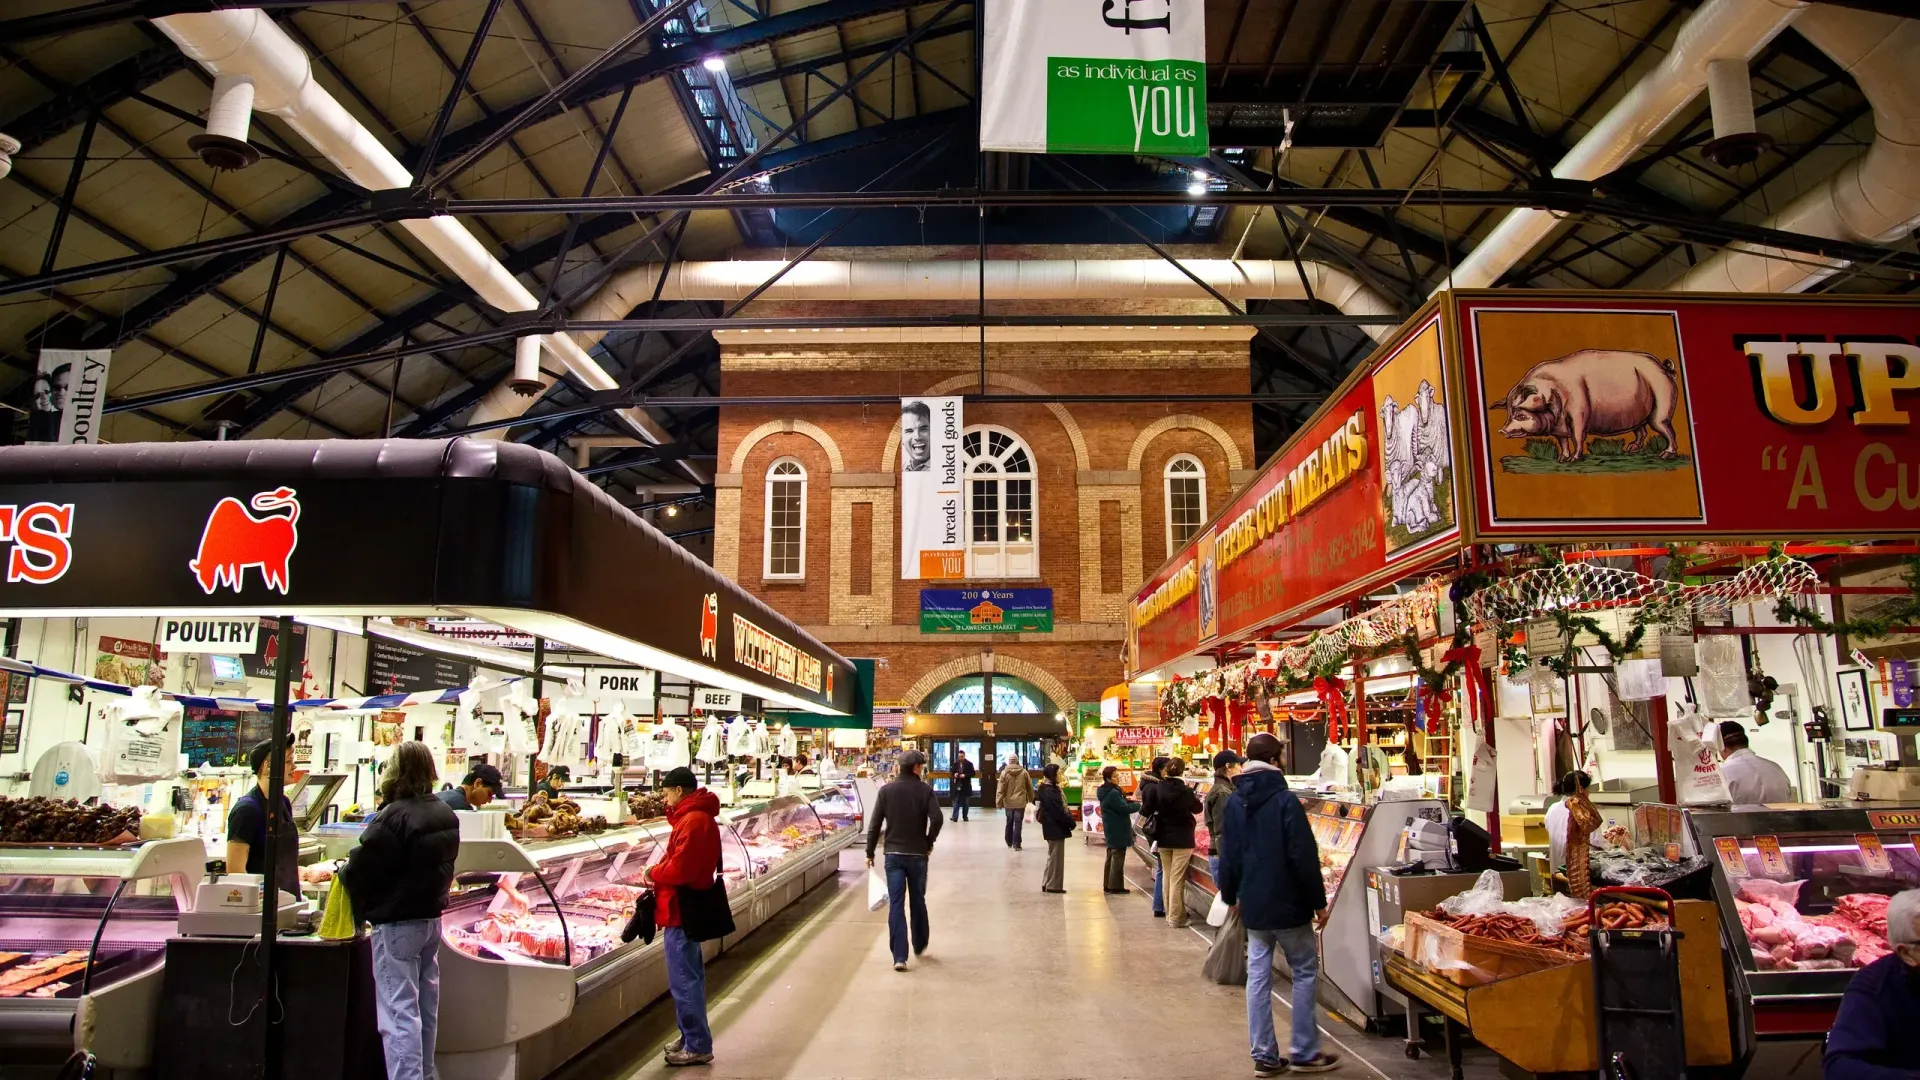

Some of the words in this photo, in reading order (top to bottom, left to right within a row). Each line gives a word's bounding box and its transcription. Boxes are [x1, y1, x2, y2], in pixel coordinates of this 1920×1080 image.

[1102, 0, 1171, 36] f
[1057, 65, 1080, 79] as
[1085, 64, 1170, 81] individual
[1175, 68, 1197, 82] as
[1128, 85, 1196, 152] you
[942, 400, 959, 440] goods
[942, 443, 956, 486] baked
[1214, 508, 1258, 571] UPPER
[1256, 482, 1290, 541] CUT
[1288, 410, 1367, 518] MEATS
[942, 499, 957, 546] breads
[961, 591, 979, 600] 200
[991, 591, 1014, 600] Years
[165, 620, 257, 644] POULTRY
[993, 623, 1017, 631] MARKET
[599, 675, 639, 692] PORK
[704, 693, 732, 706] BEEF
[1116, 727, 1165, 738] TAKE-OUT
[1693, 763, 1717, 773] MEAT
